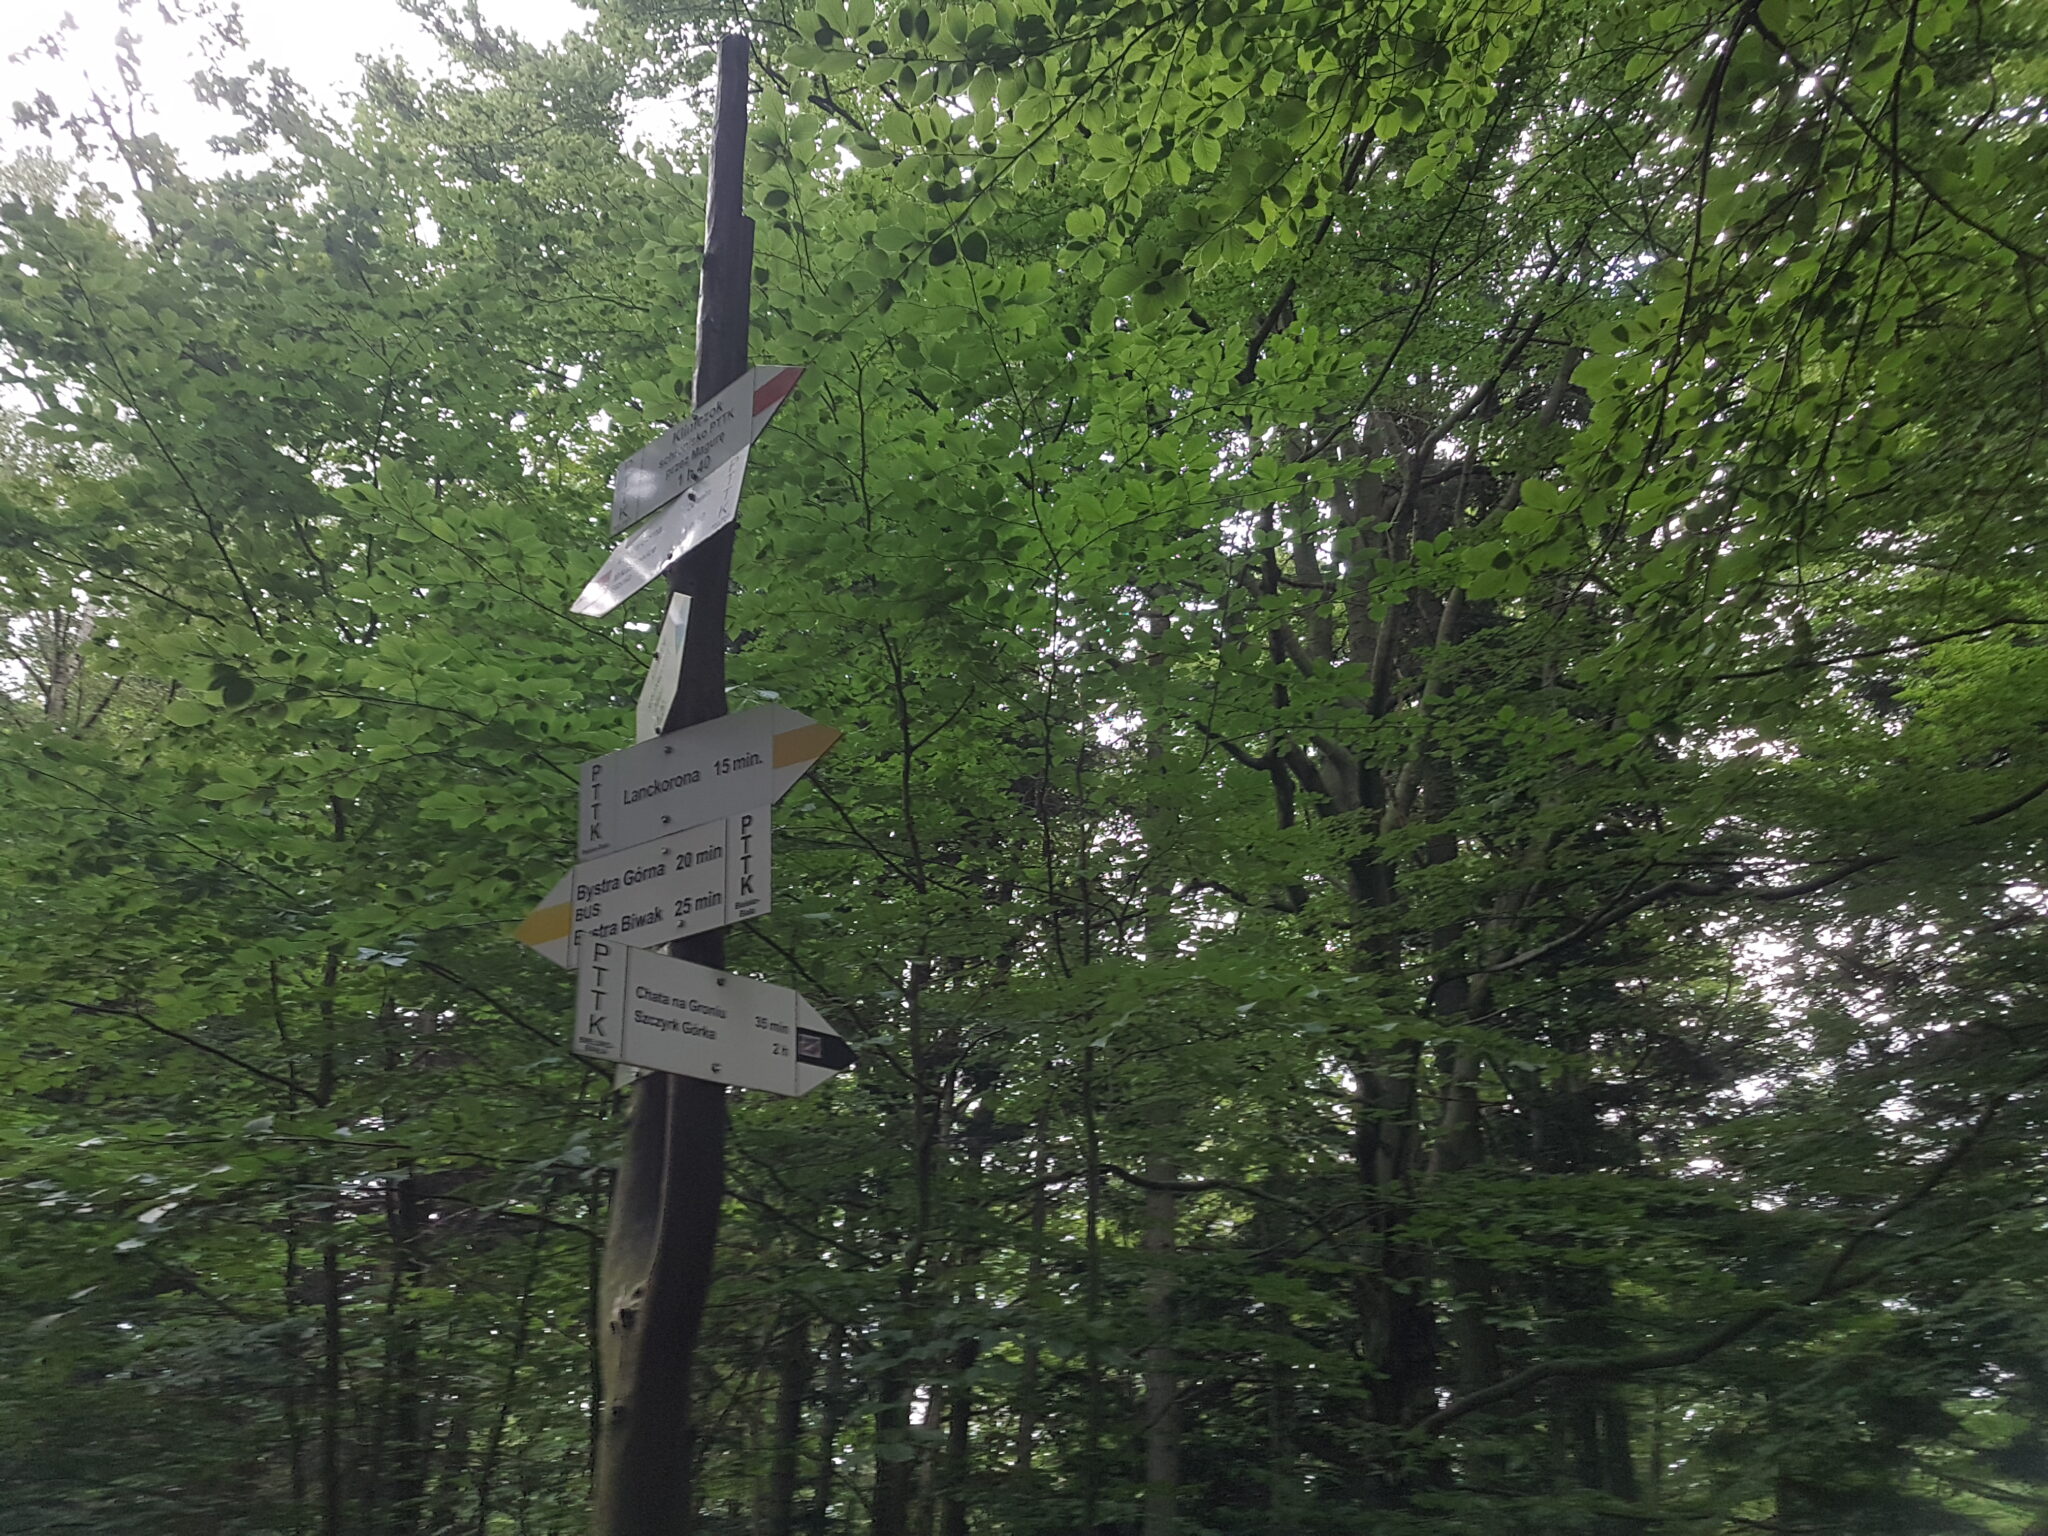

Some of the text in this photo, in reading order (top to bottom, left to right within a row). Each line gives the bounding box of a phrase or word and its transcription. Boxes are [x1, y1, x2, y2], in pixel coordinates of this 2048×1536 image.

[590, 764, 603, 841] PTTK
[623, 751, 764, 806] Lanckorona 15 min.
[576, 844, 723, 902] Bystra Górna 20 min
[741, 814, 754, 896] PTTK
[574, 922, 618, 946] Bstra
[620, 906, 664, 932] Biwak
[674, 899, 692, 918] 25
[694, 891, 722, 912] min
[575, 902, 601, 922] BUS
[588, 942, 610, 1038] PTTK
[635, 985, 671, 1008] Chata
[671, 997, 687, 1010] na
[754, 1015, 768, 1031] 35
[769, 1019, 790, 1034] min
[634, 1009, 681, 1032] Szczyrk
[772, 1043, 779, 1056] 2
